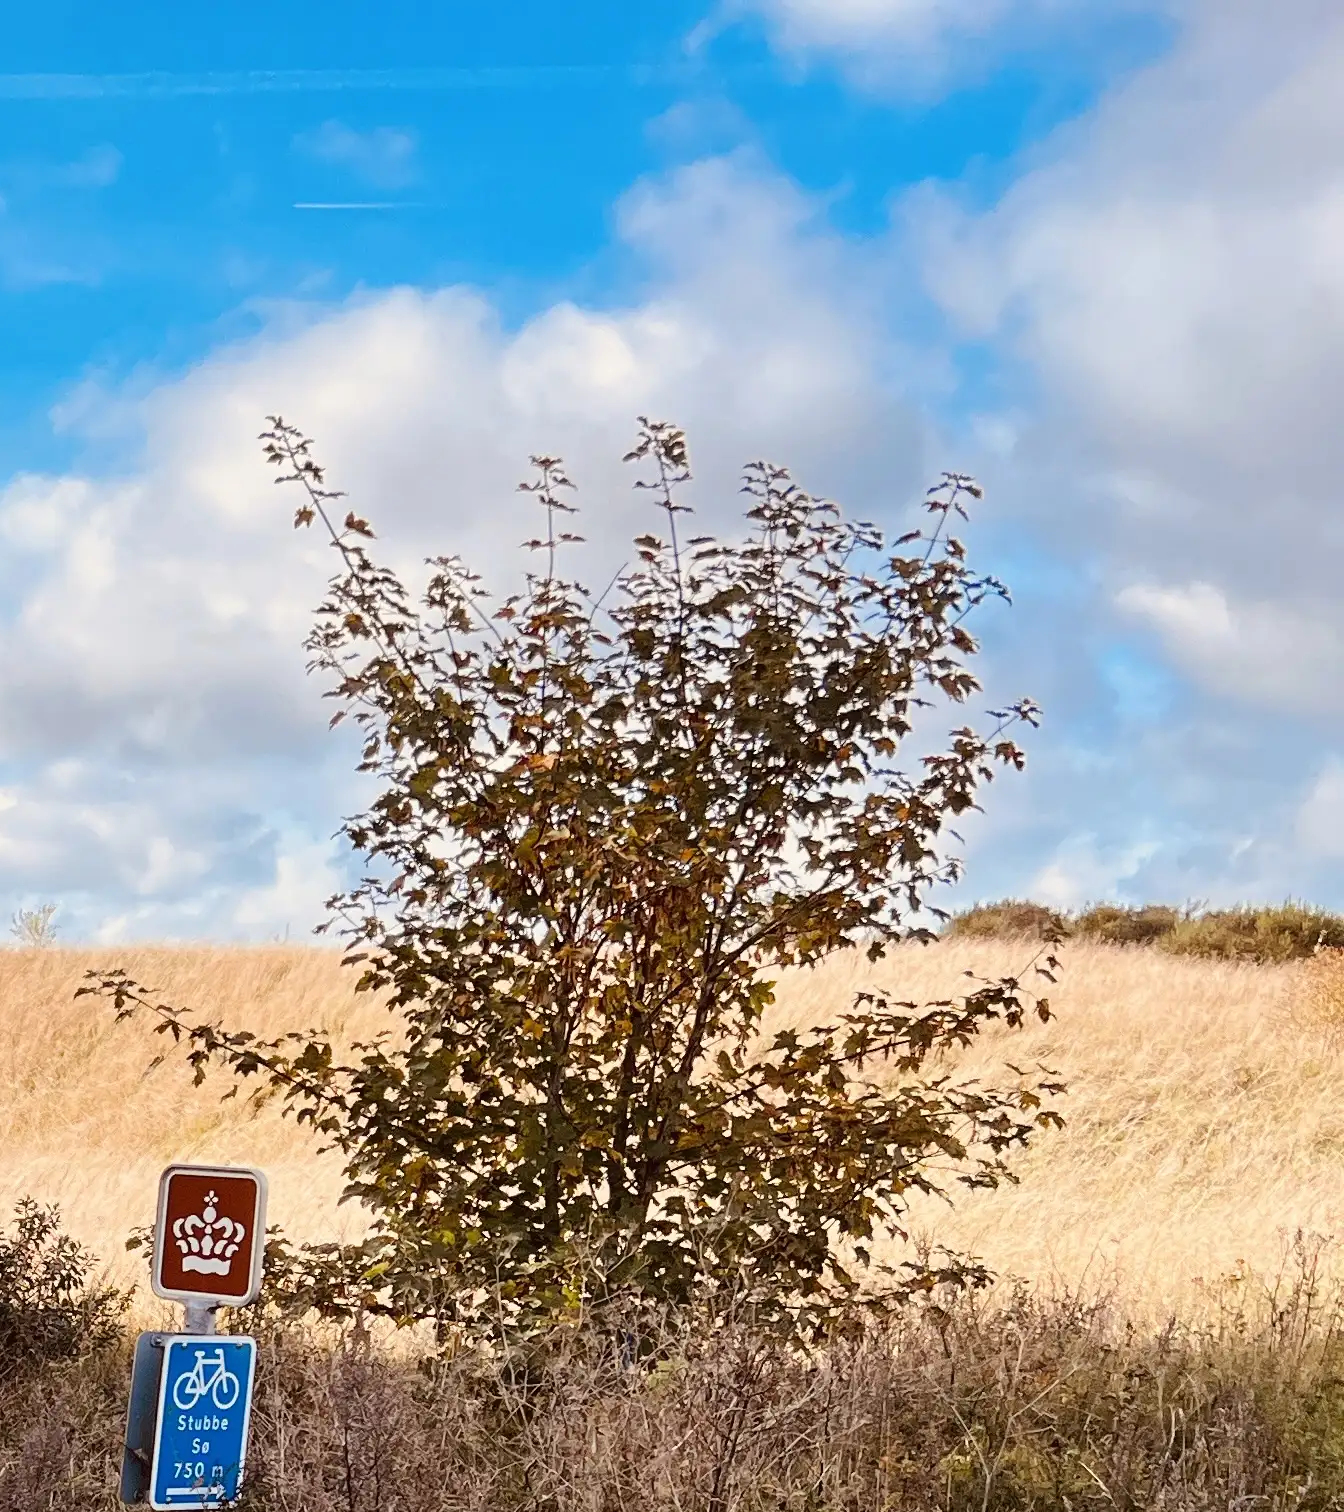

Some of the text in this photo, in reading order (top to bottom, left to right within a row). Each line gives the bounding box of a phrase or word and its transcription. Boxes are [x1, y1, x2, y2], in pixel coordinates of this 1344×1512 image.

[177, 1414, 229, 1431] Stubbe
[191, 1437, 210, 1454] Sø
[174, 1461, 224, 1479] 750 m
